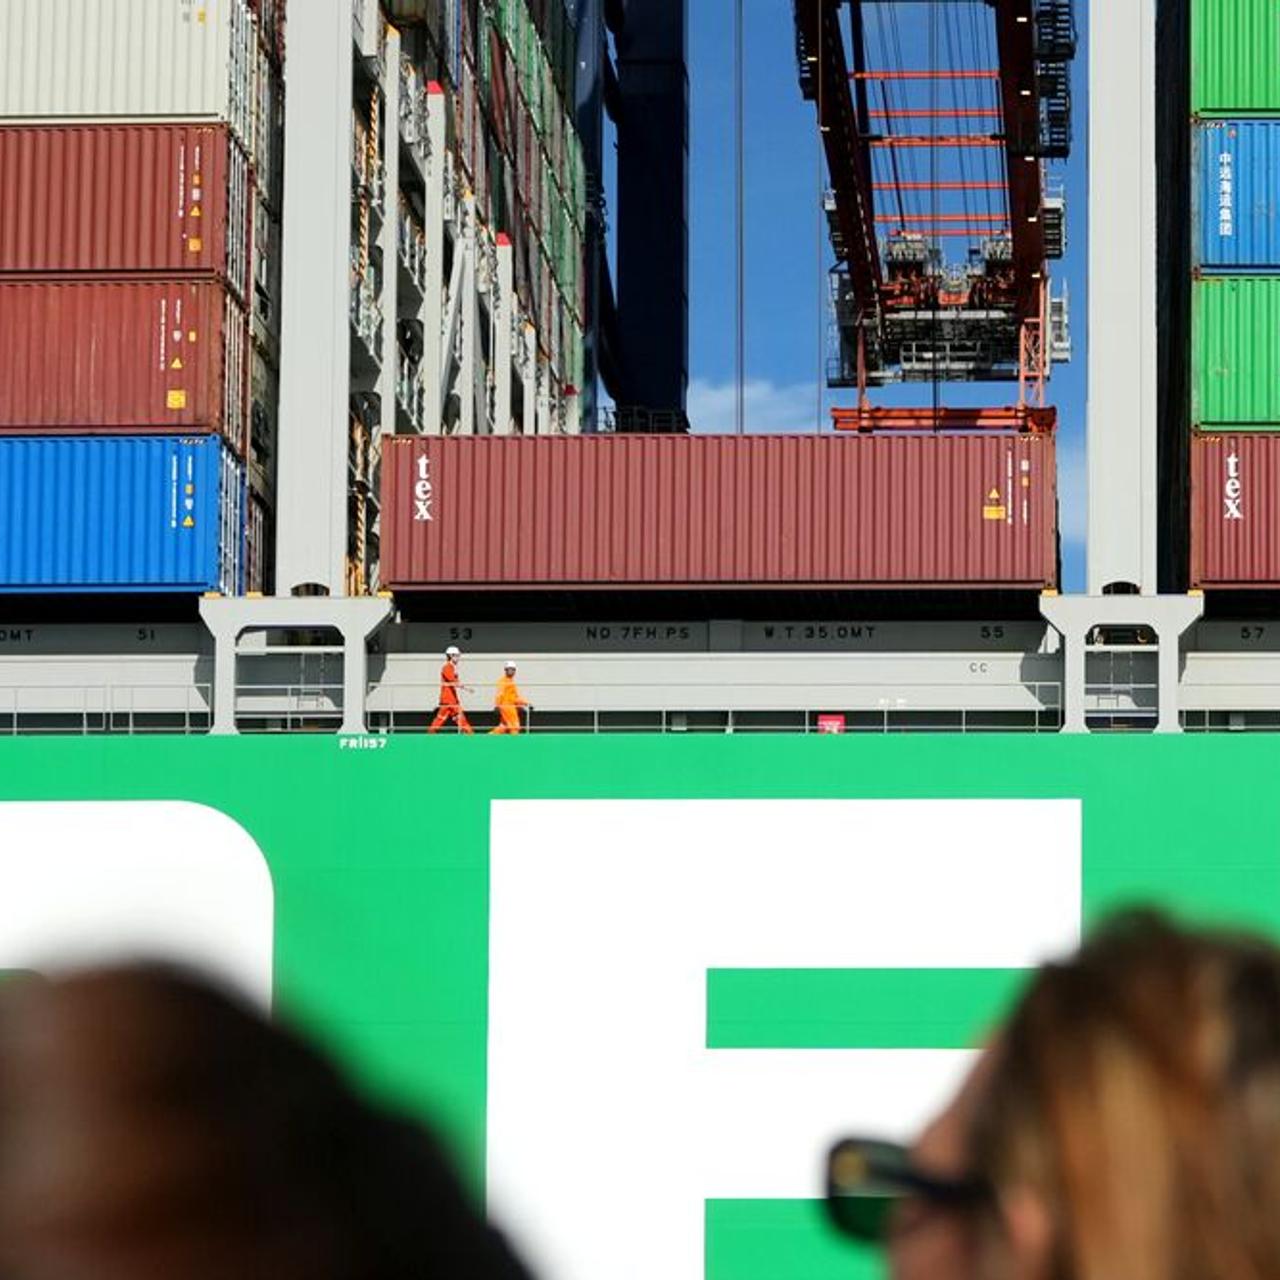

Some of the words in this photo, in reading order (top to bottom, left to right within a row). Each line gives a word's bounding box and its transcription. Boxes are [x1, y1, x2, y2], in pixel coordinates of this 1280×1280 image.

[414, 453, 433, 521] tex
[1223, 452, 1243, 519] tex
[137, 628, 155, 641] 51
[450, 627, 473, 640] 53
[980, 625, 1005, 639] 55
[1240, 626, 1265, 640] 57
[969, 662, 988, 673] CC
